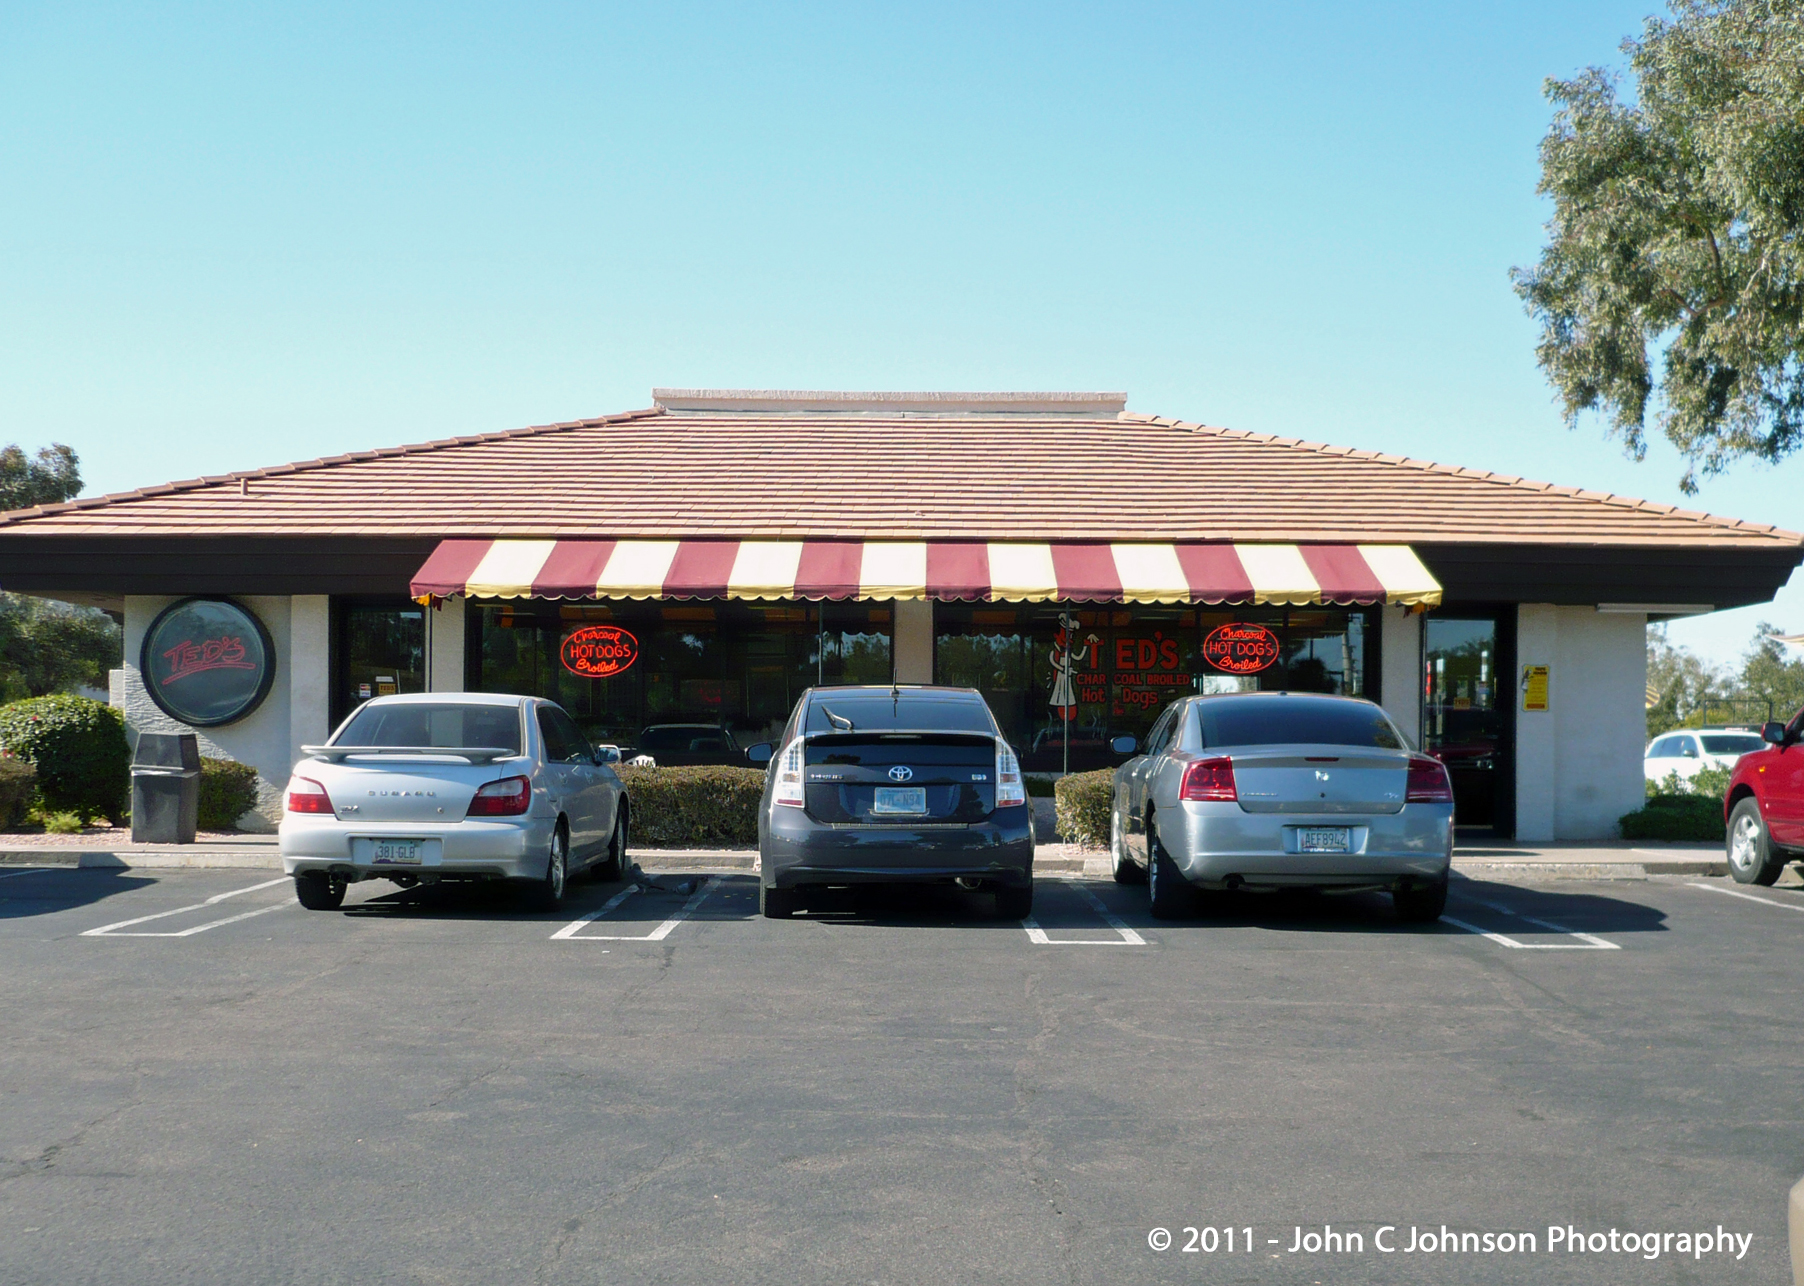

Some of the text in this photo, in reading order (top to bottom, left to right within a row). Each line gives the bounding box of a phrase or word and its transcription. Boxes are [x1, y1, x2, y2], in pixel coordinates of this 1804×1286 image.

[573, 630, 622, 645] Charcoal
[1220, 627, 1266, 642] Charcoal
[163, 636, 246, 671] TED'S
[570, 643, 631, 658] HOT DOGS
[1209, 643, 1274, 656] HOT DOGS
[576, 658, 618, 674] Broiled
[1218, 656, 1262, 670] Broiled
[1076, 674, 1190, 686] CHAR COAL BROILED
[1081, 687, 1158, 710] Hot Dogs
[1305, 832, 1346, 846] AEF8942
